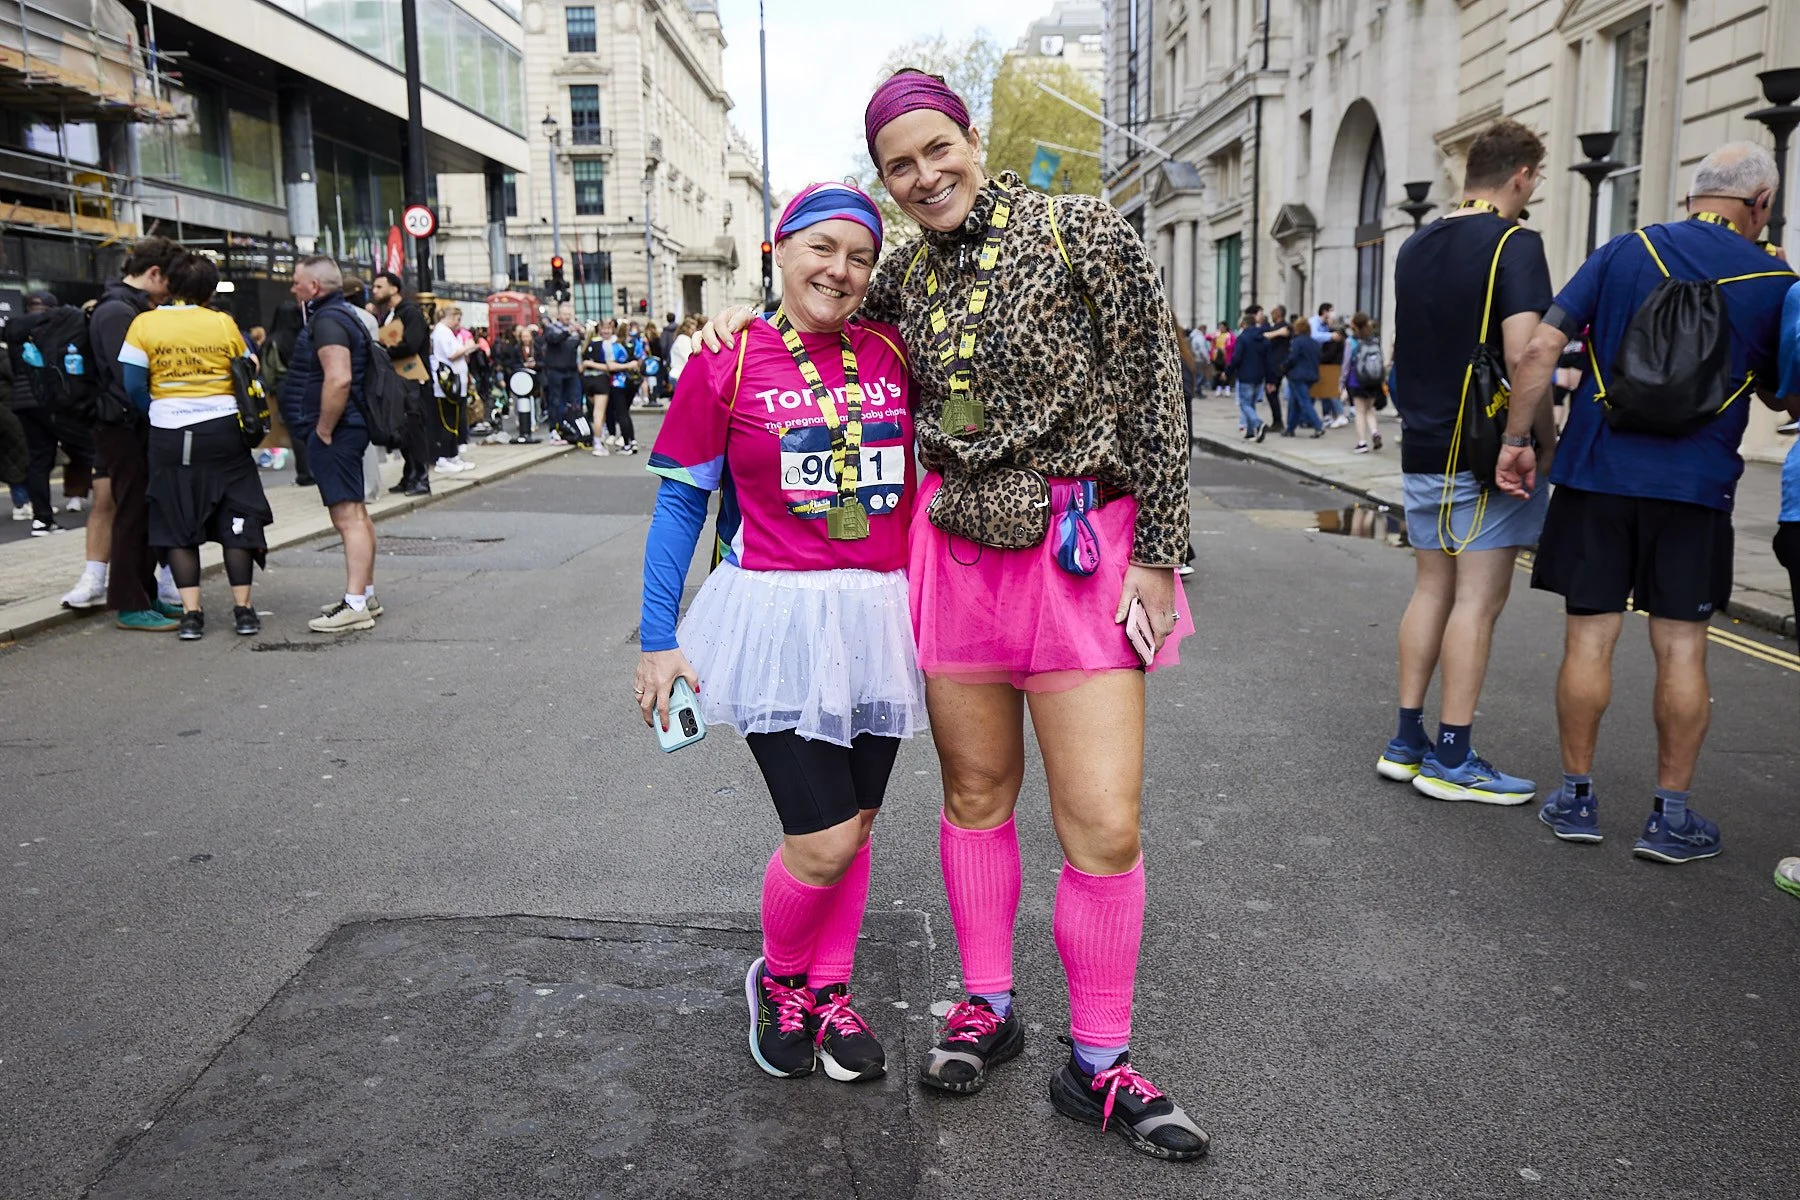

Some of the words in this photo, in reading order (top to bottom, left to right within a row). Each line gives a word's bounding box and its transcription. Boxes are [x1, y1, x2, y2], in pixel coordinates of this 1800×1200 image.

[409, 215, 429, 227] 20
[154, 345, 187, 355] We're
[156, 358, 171, 367] for
[185, 357, 203, 366] life
[764, 421, 783, 430] The
[785, 416, 826, 429] pregnan
